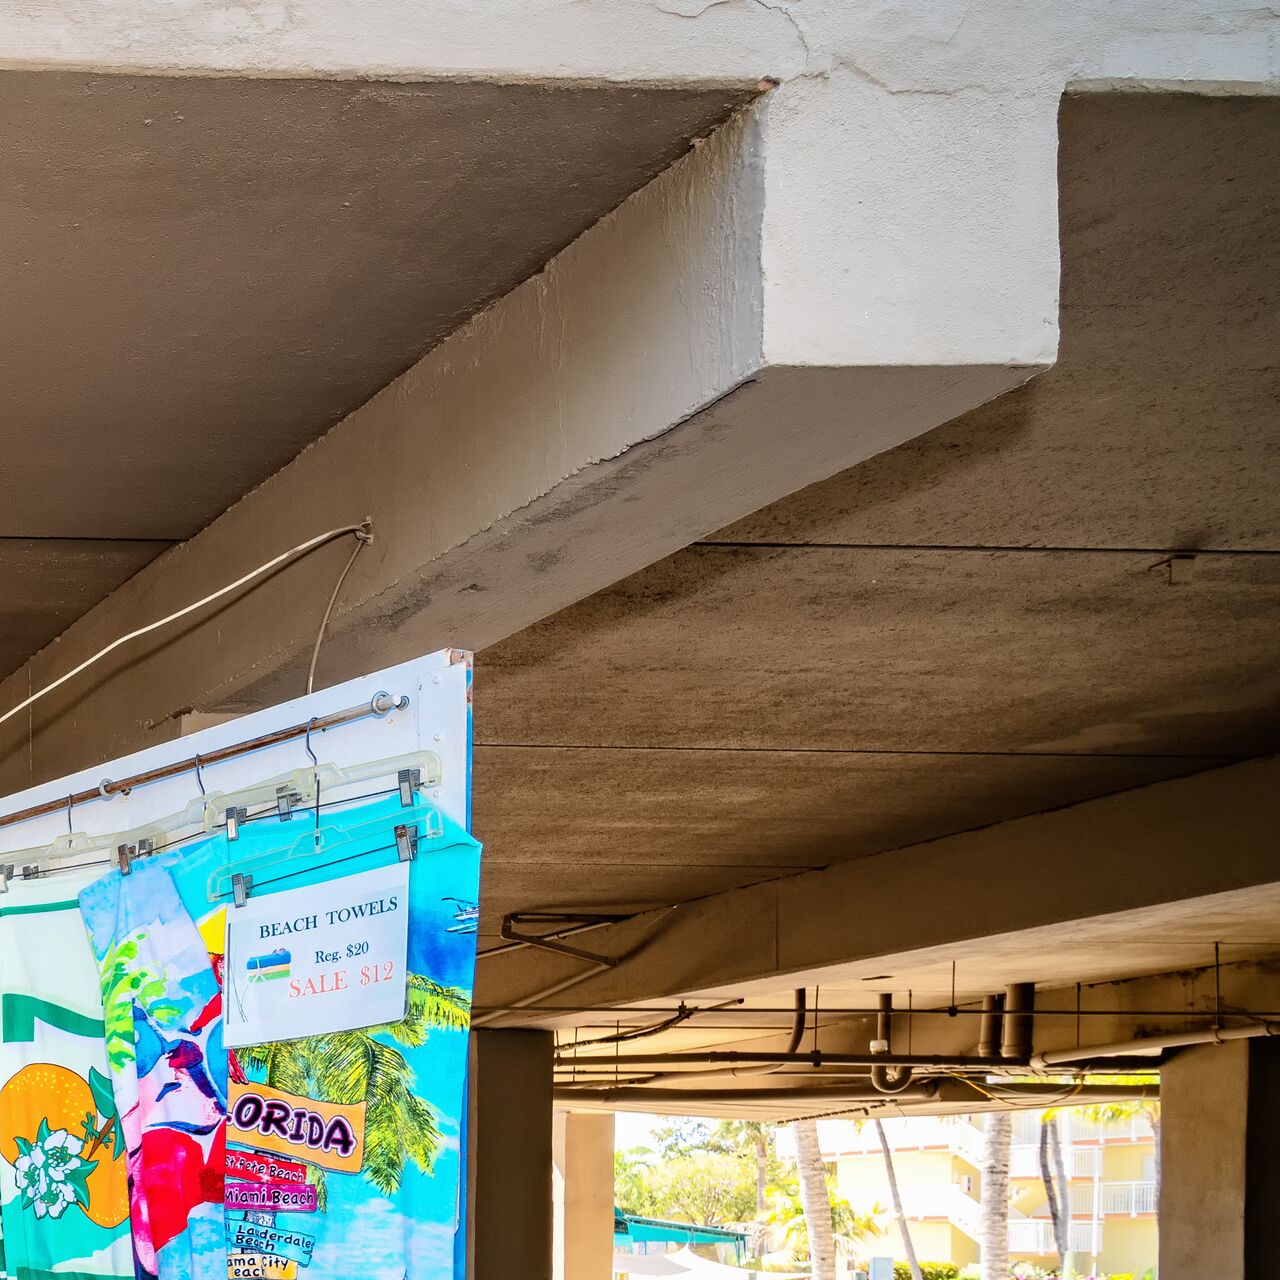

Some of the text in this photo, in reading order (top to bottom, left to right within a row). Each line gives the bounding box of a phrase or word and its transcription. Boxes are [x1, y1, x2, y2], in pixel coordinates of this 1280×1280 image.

[259, 896, 398, 939] BEACH TOWELS
[315, 941, 369, 963] Reg. $20
[289, 960, 393, 998] SALE $12
[227, 1094, 355, 1156] ORIDA
[269, 1165, 304, 1182] Beach
[271, 1190, 315, 1205] Beach
[235, 1234, 275, 1252] Beach
[237, 1225, 311, 1249] Lauderdale
[227, 1255, 289, 1271] ama City
[234, 1267, 265, 1277] each
